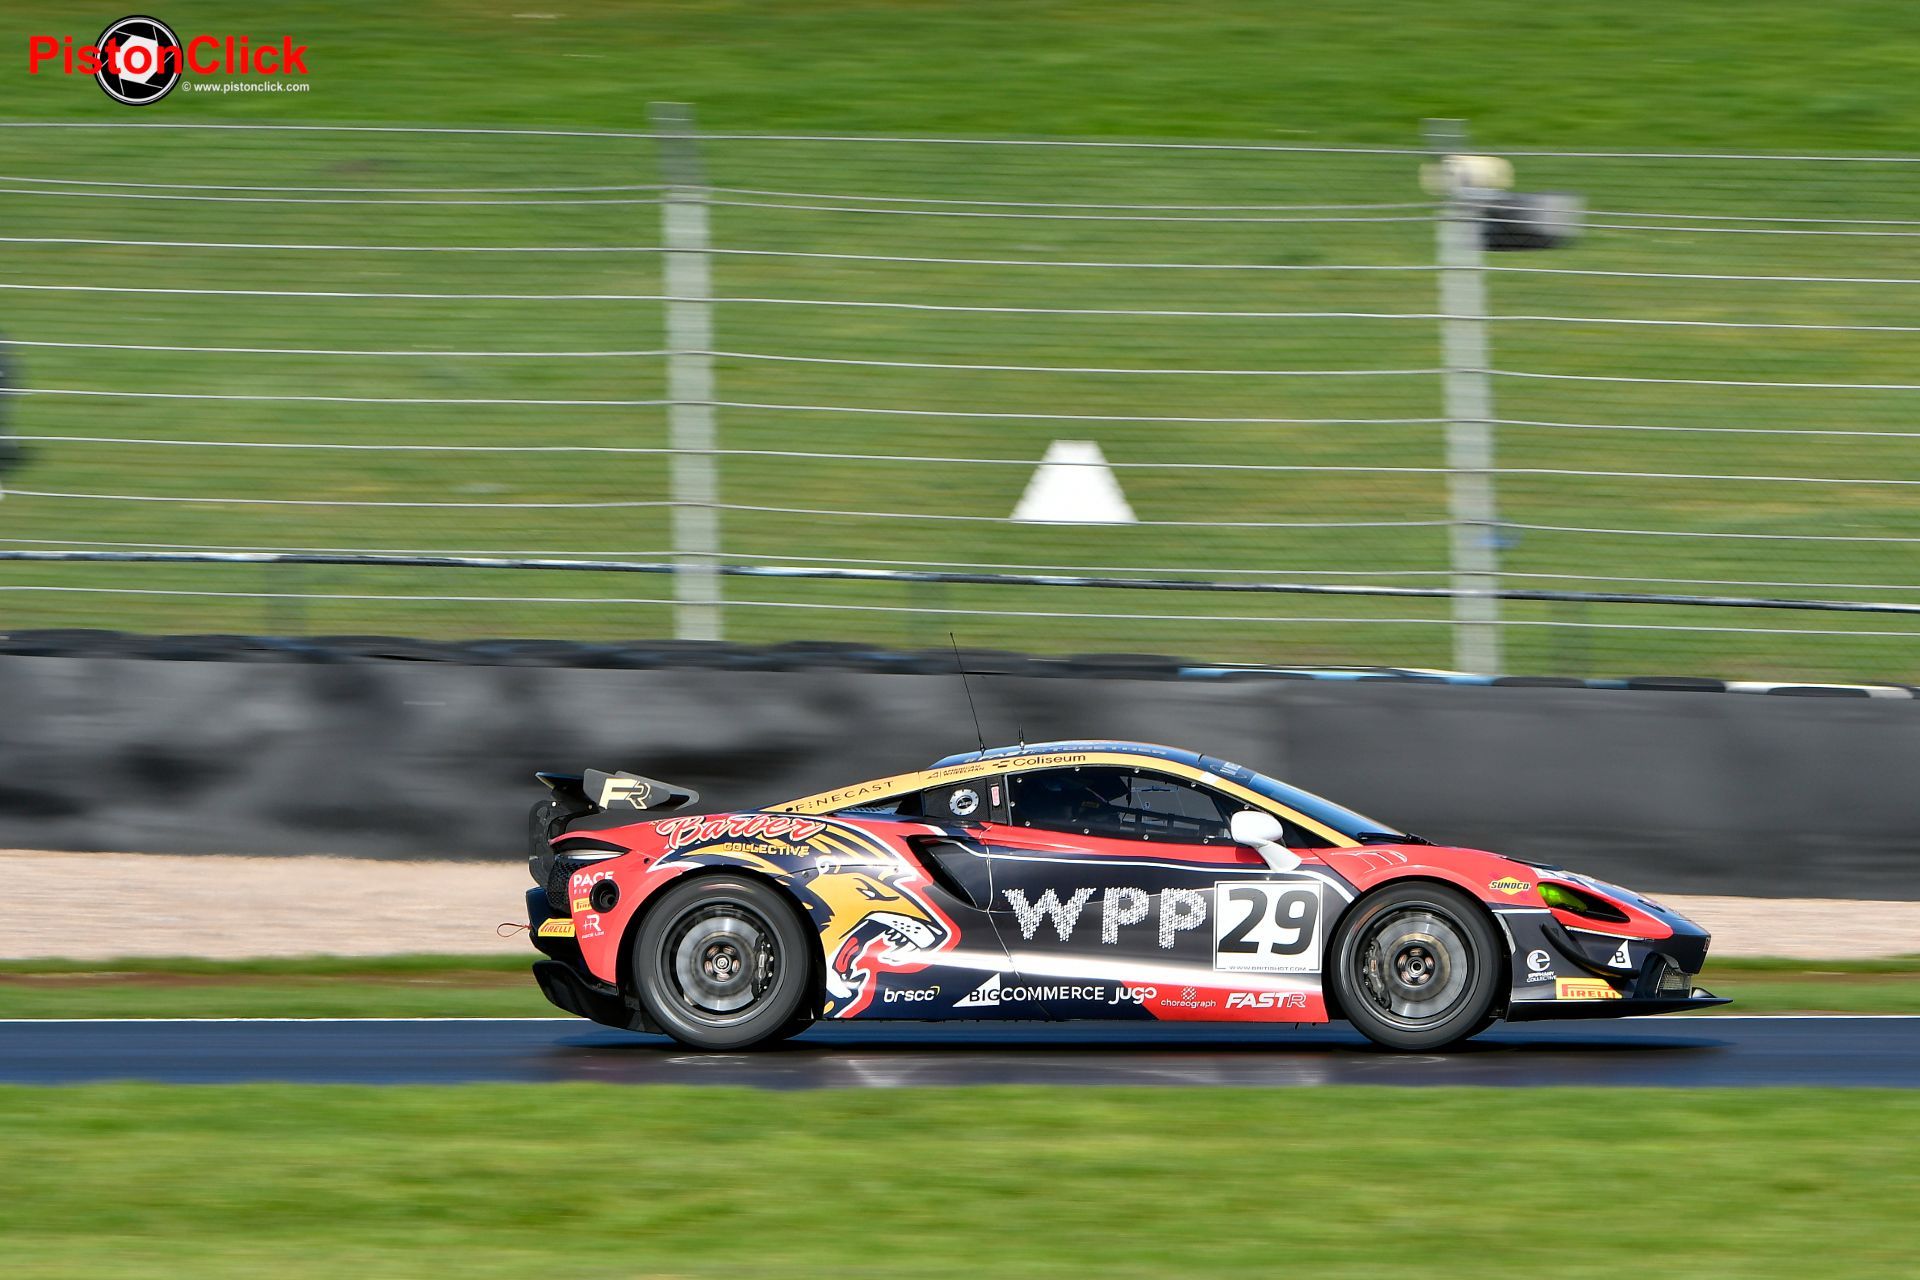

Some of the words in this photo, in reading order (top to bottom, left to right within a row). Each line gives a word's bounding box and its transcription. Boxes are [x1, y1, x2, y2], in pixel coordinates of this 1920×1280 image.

[1013, 754, 1087, 768] Coliseum
[656, 815, 827, 850] Barber
[722, 842, 810, 857] COLLECTIVE
[1490, 881, 1530, 891] SUNOCO
[1002, 887, 1207, 949] WPP
[1218, 888, 1319, 955] 29
[884, 988, 935, 1003] brscc
[1562, 983, 1618, 999] PIRELLI
[1160, 999, 1216, 1009] choreograph
[1225, 992, 1307, 1009] FASTR
